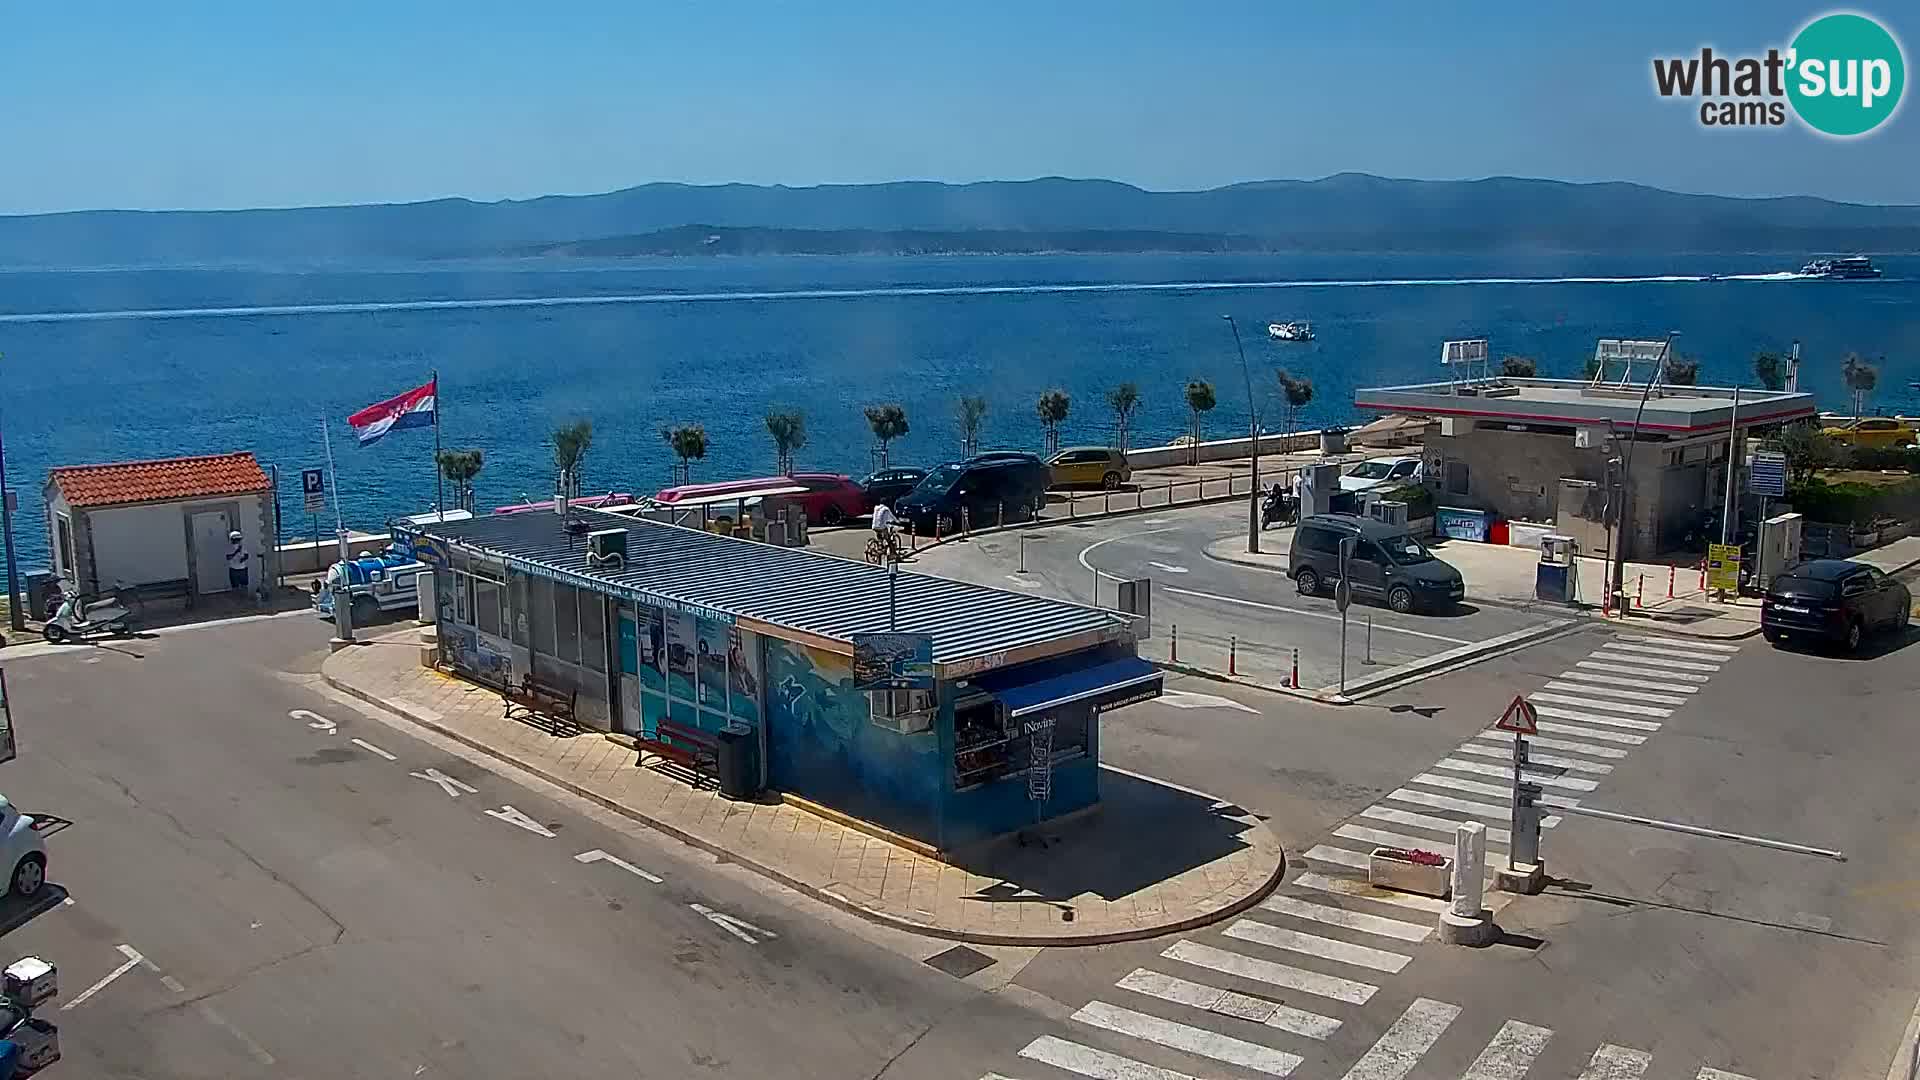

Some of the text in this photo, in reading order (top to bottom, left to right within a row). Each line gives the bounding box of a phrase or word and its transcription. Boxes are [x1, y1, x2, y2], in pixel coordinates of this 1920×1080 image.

[647, 595, 678, 610] STATION
[680, 603, 704, 617] TICKET
[705, 608, 733, 624] OFFICE
